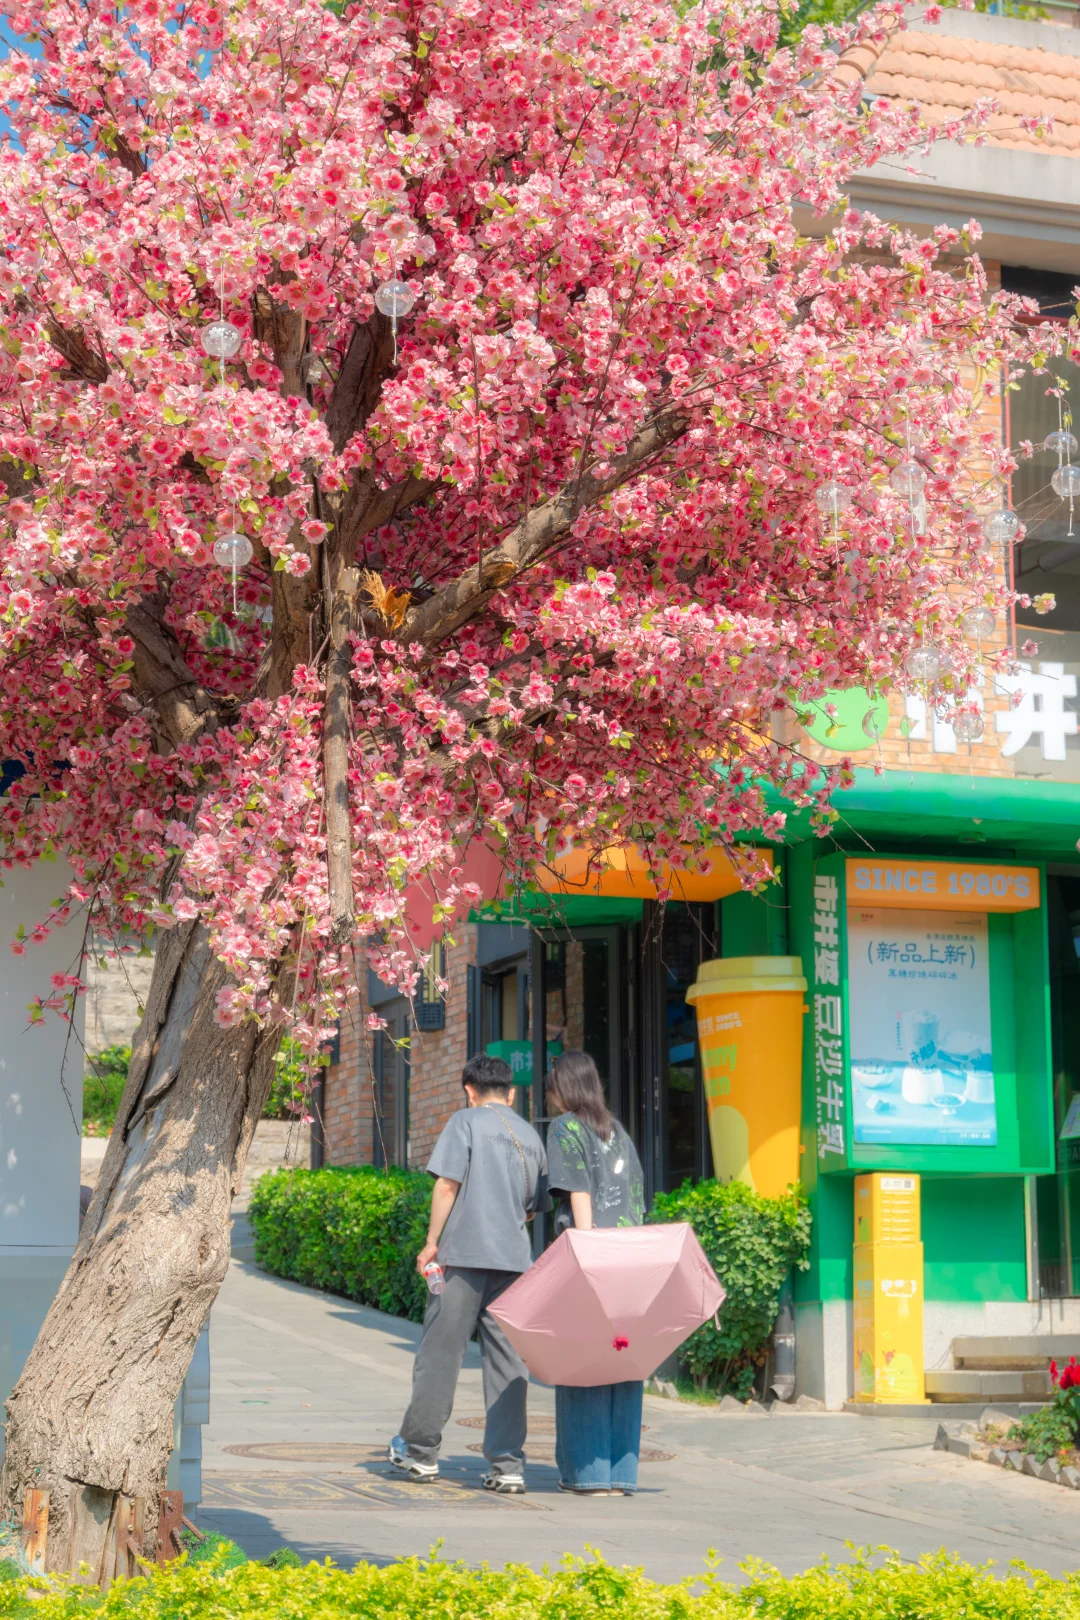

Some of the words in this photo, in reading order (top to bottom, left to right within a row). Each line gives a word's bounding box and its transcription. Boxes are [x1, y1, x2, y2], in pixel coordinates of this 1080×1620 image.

[855, 867, 937, 893] SINCE
[947, 872, 1031, 898] 1980'S
[867, 940, 976, 969] (新品上新)
[716, 1012, 739, 1022] SINCE
[816, 995, 844, 1159] 豆沙牛乳
